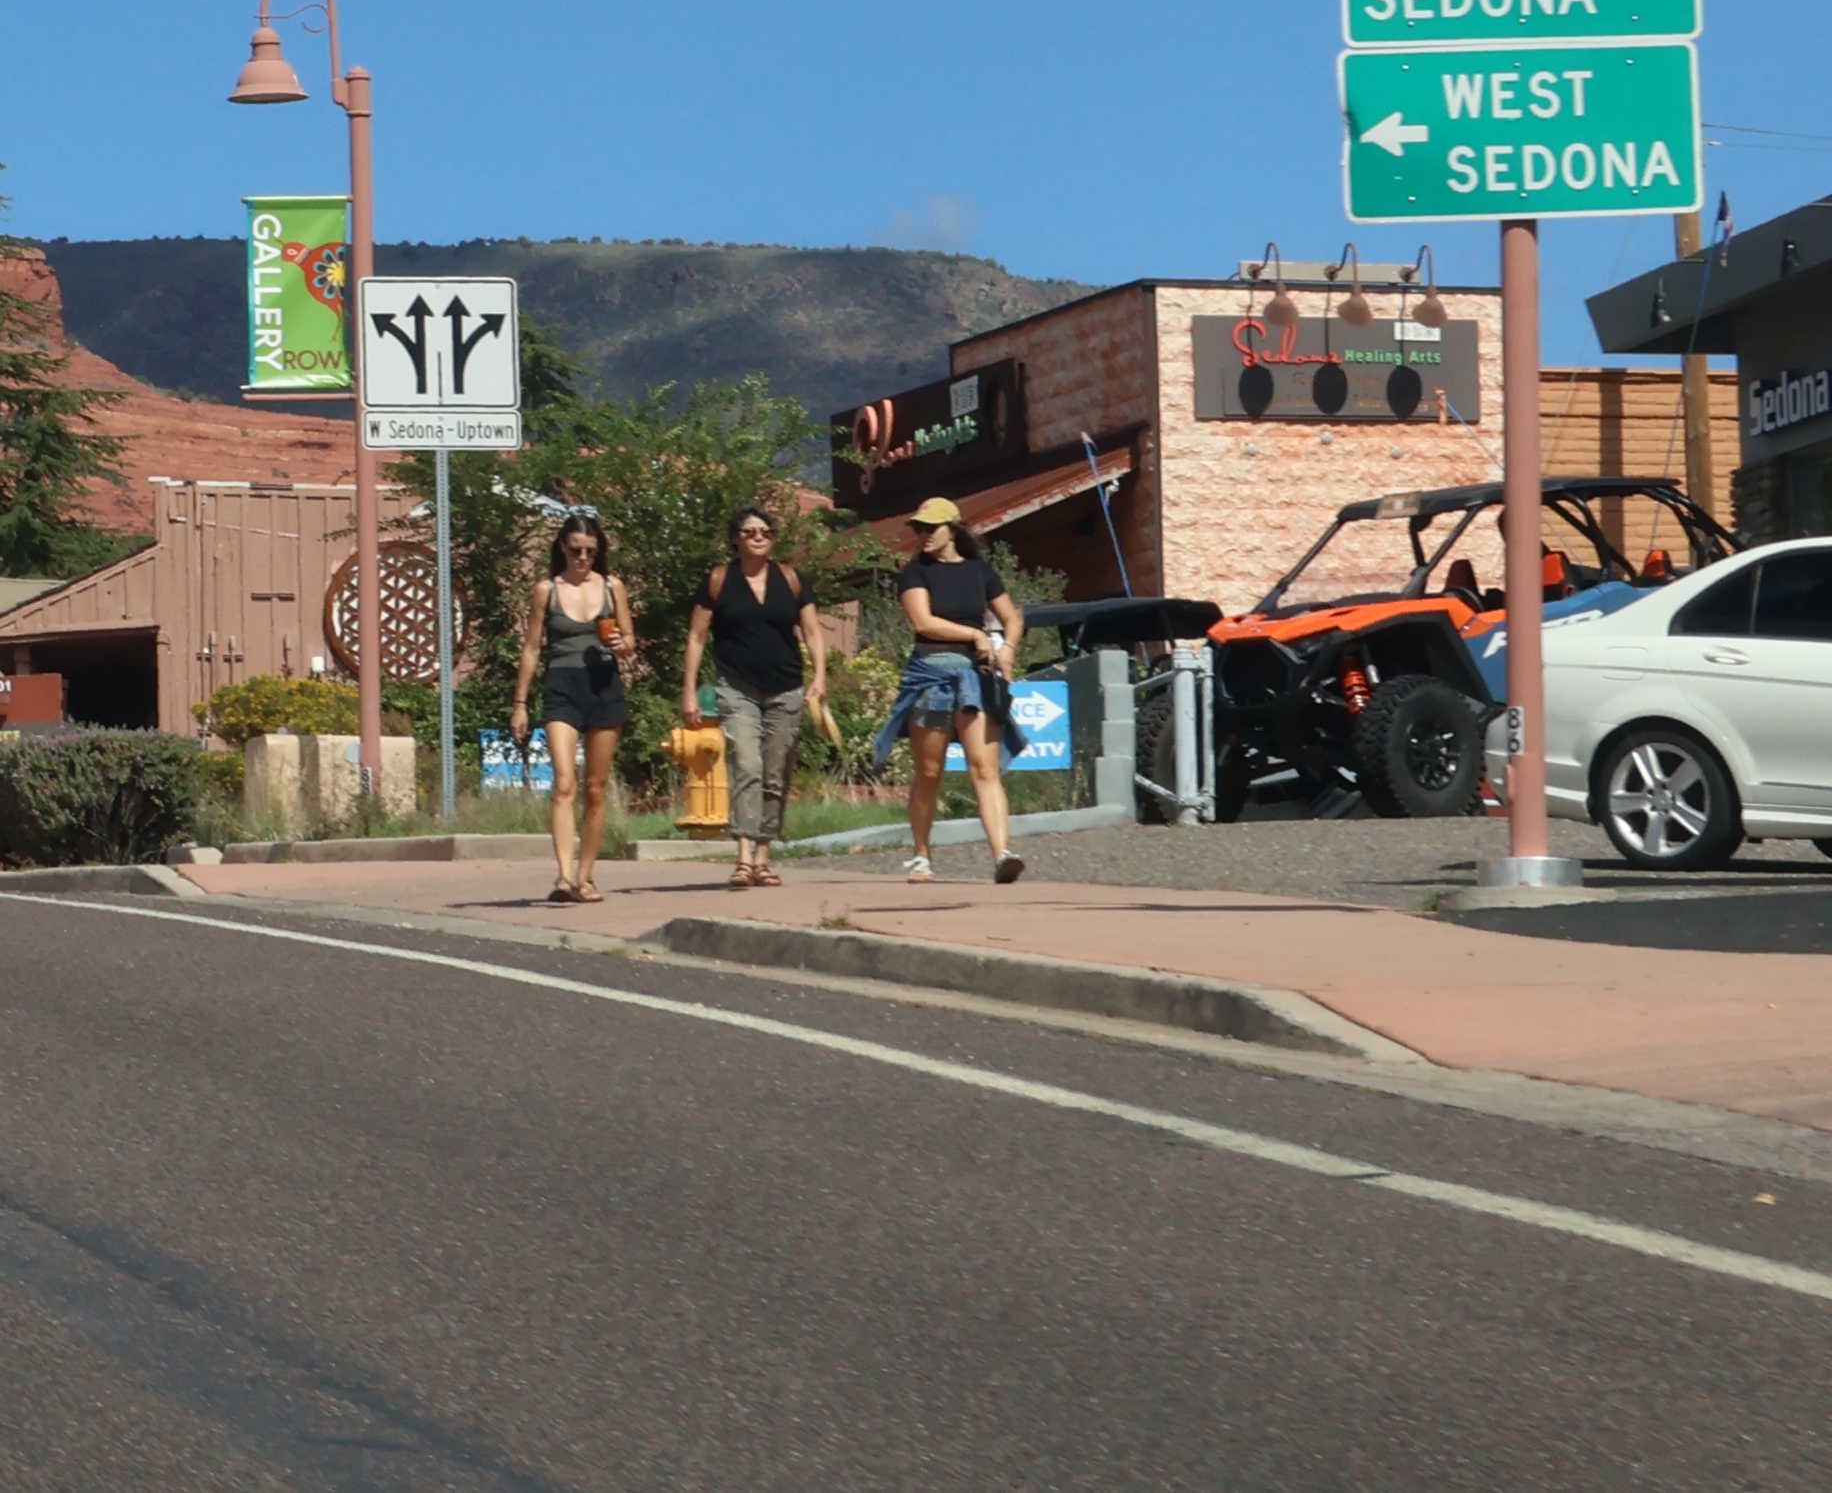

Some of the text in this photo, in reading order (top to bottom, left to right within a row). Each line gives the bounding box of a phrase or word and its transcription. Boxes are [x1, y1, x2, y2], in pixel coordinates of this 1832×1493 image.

[1441, 70, 1594, 120] WEST
[1446, 141, 1680, 194] SEDONA
[252, 213, 283, 371] GALLERY
[283, 350, 344, 371] ROW
[1344, 348, 1402, 366] Healing
[1410, 350, 1441, 363] Arts
[1749, 370, 1830, 437] Sedona
[369, 420, 382, 438] W
